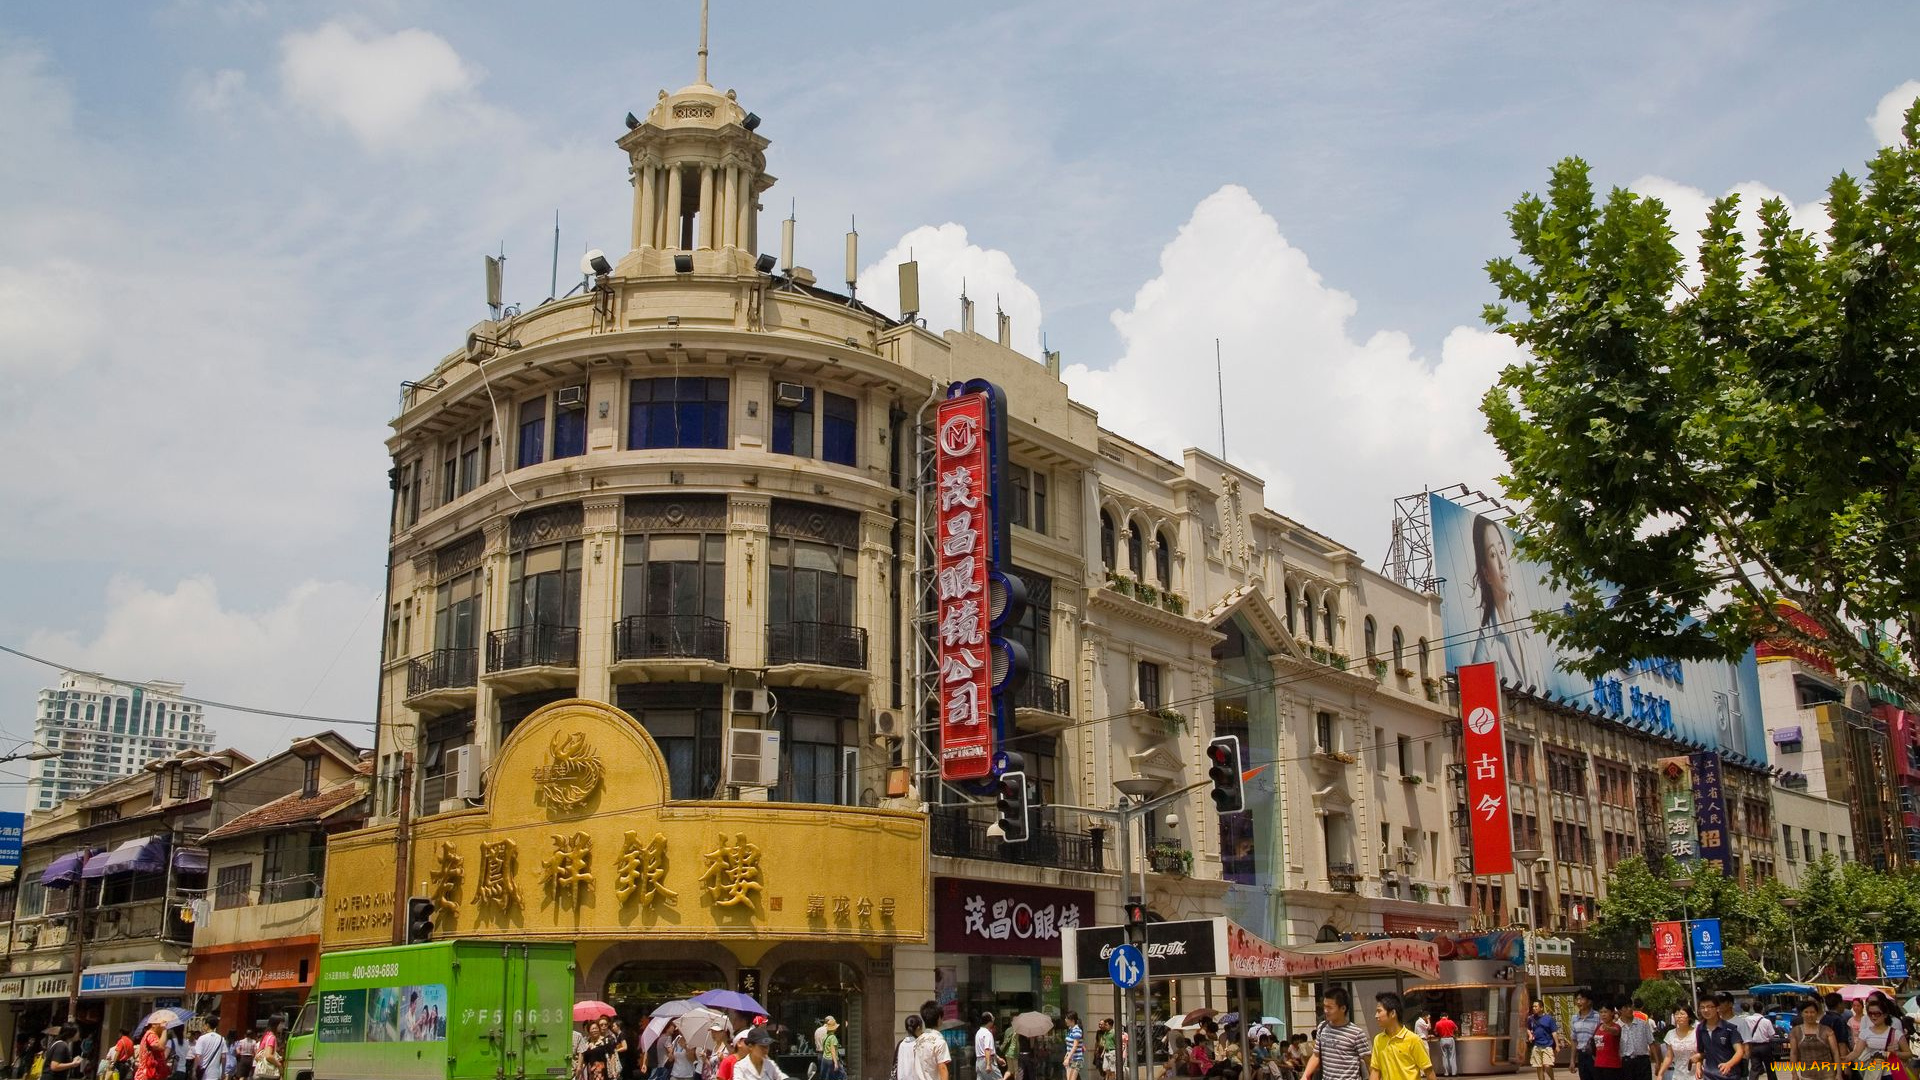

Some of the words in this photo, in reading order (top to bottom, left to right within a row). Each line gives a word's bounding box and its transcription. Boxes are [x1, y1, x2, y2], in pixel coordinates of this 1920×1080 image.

[941, 466, 983, 725] 茂昌眼镜公司
[1630, 686, 1675, 732] 洗衣机
[1473, 753, 1502, 821] 古今
[335, 897, 349, 912] LAO
[352, 894, 371, 910] FENG
[337, 914, 370, 932] JEWELRY
[371, 911, 393, 928] SHOP
[965, 895, 1012, 940] 茂昌
[231, 953, 255, 970] EASY
[353, 963, 399, 979] 400-889-6888
[238, 969, 263, 990] SHOP
